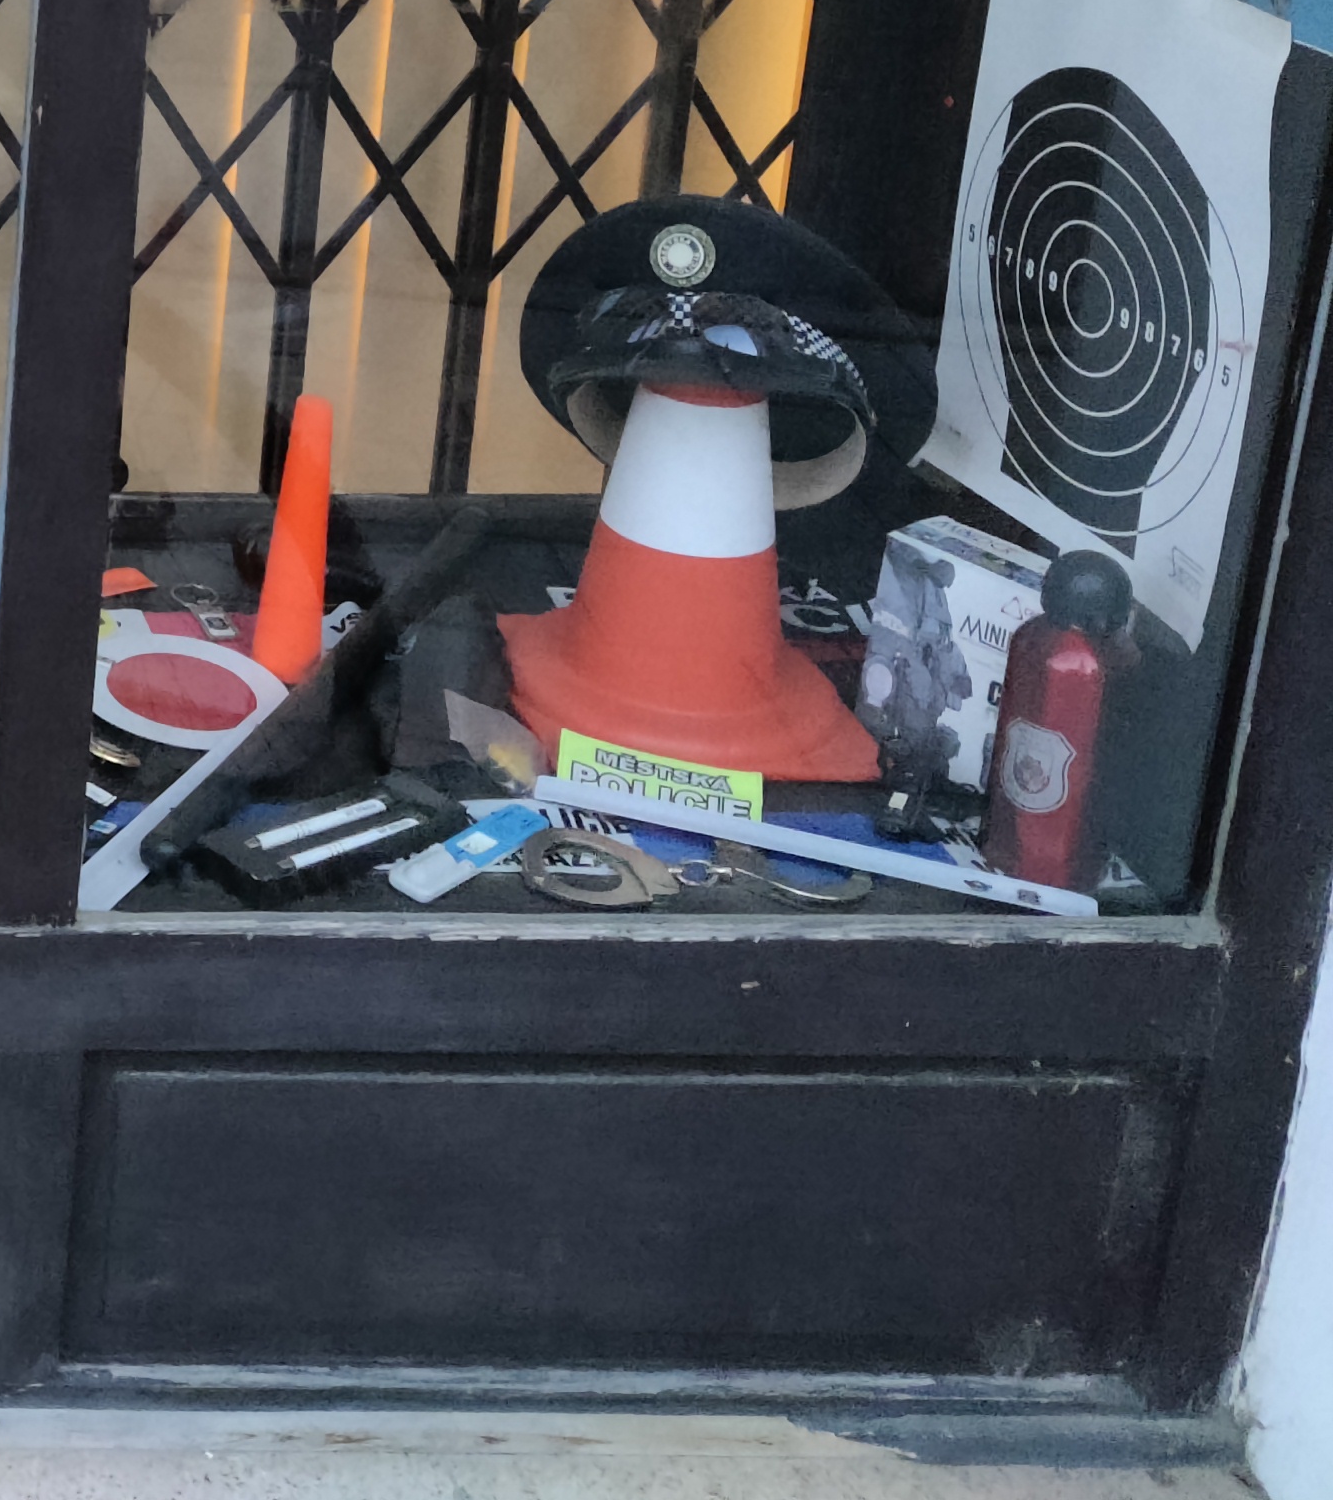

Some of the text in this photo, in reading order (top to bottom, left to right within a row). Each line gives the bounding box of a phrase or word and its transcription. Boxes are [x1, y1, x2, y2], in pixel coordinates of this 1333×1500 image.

[968, 223, 1058, 292] 5 6 7 8 9
[1119, 307, 1231, 387] 9 8 7 6 5
[595, 748, 733, 795] MĚSTSKÁ
